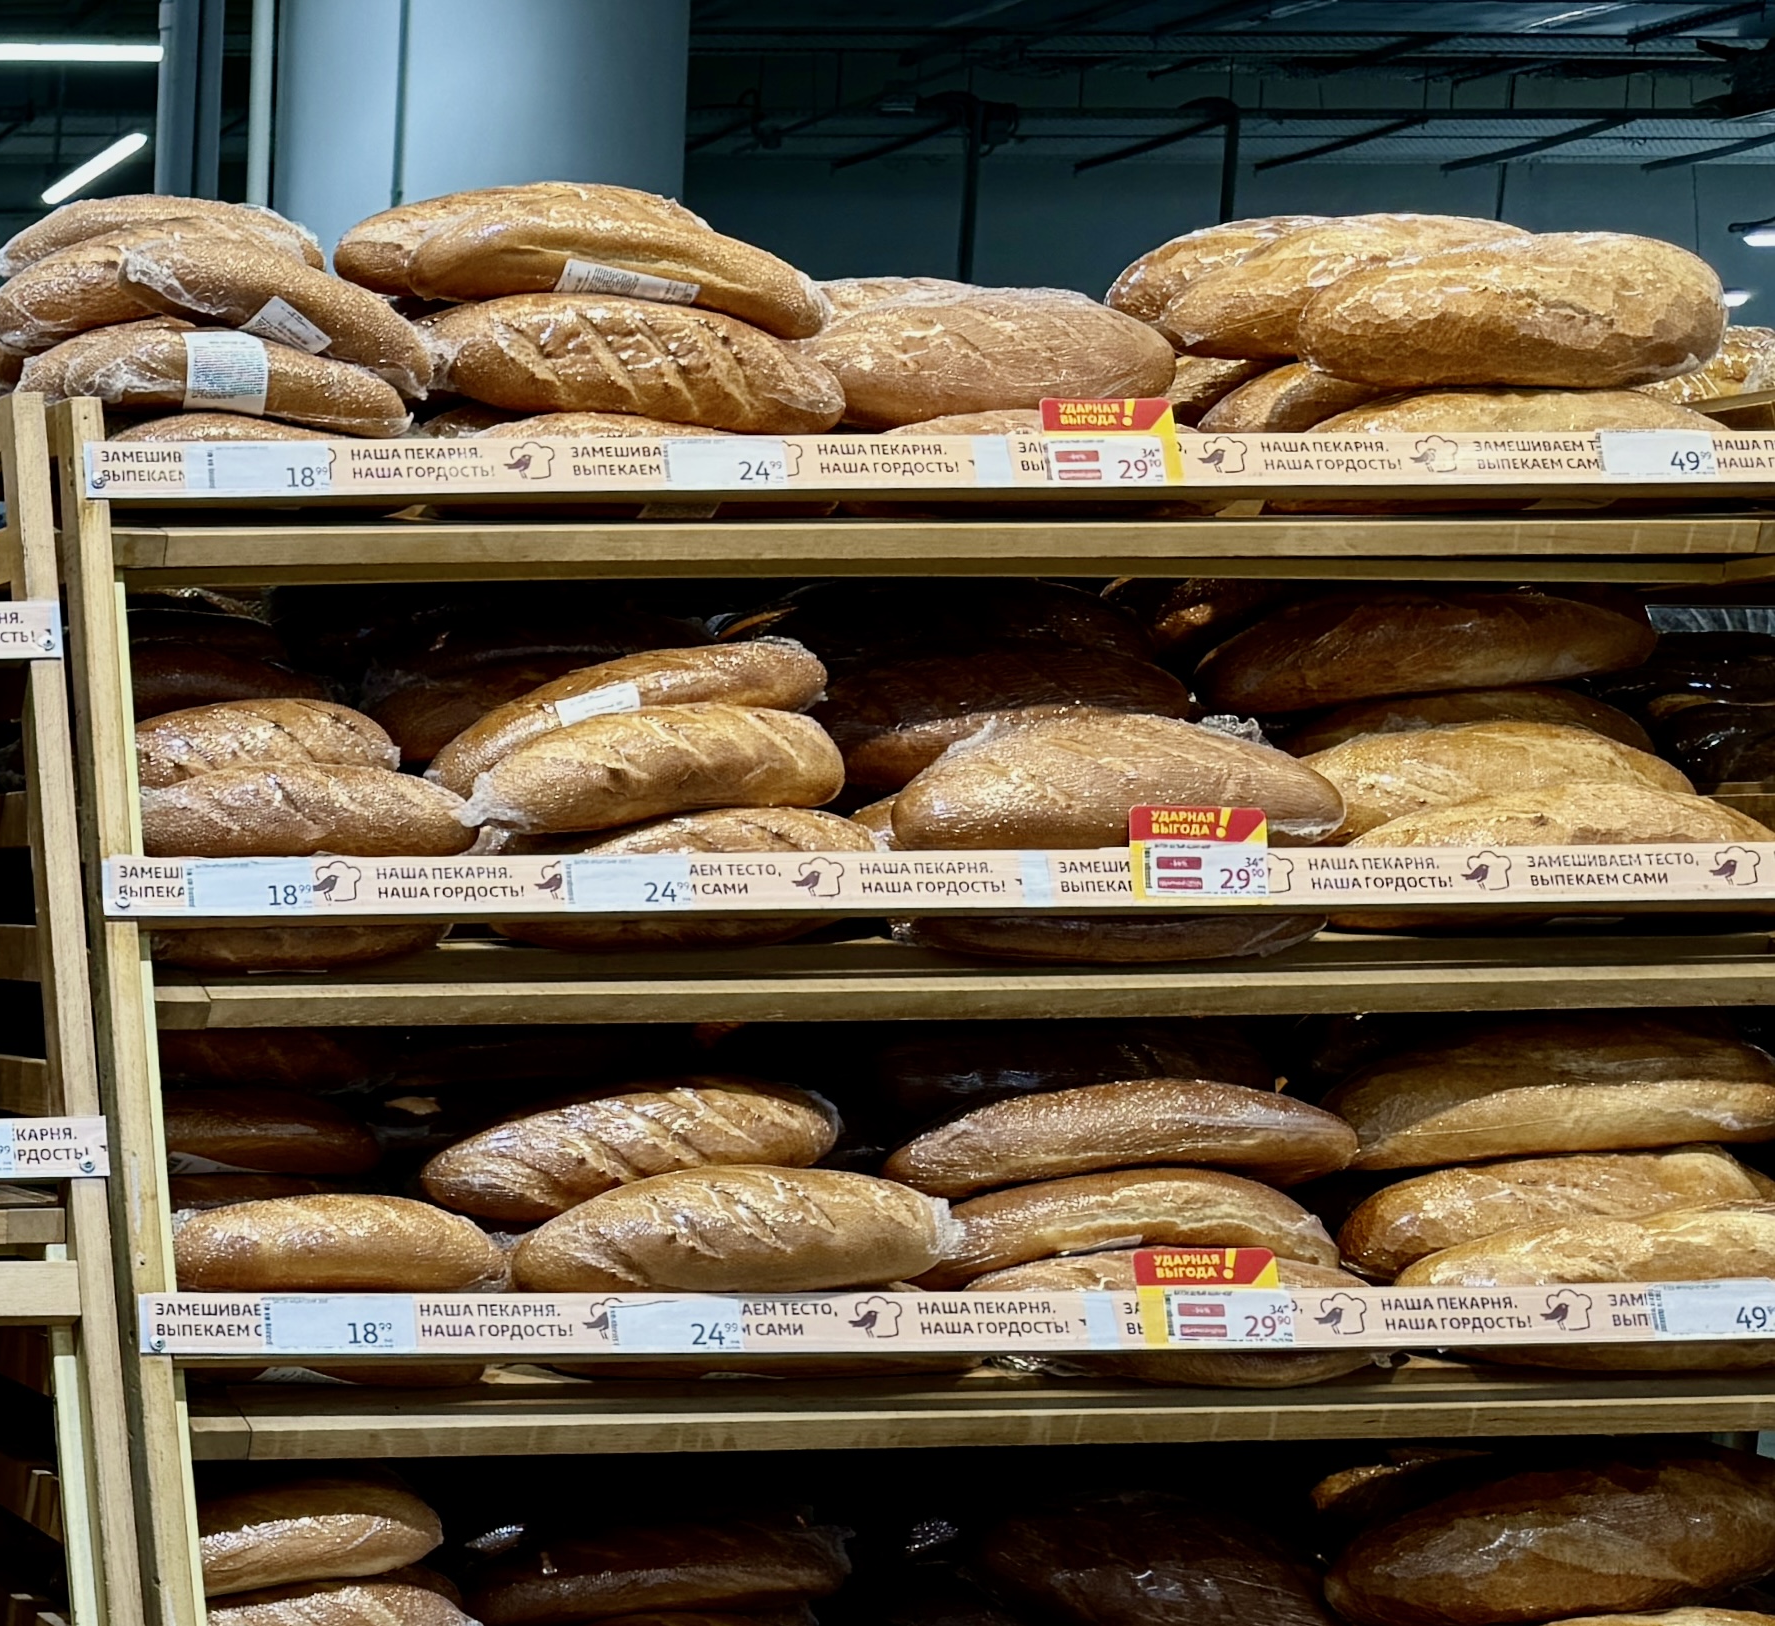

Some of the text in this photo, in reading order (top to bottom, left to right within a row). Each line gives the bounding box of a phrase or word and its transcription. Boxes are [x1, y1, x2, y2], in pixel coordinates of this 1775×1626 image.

[1058, 403, 1120, 414] УДАРНАЯ
[1060, 414, 1117, 427] ВЫГОДА
[817, 444, 947, 455] НАША ПЕКАРНЯ.
[1261, 441, 1389, 452] НАША ПЕКАРНЯ.
[351, 447, 483, 460] НАША ПЕКАРНЯ.
[820, 462, 959, 476] НАША ГОРДОСТЬ!
[1264, 459, 1401, 472] НАША ГОРДОСТЬ!
[353, 466, 494, 481] НАША ГОРДОСТЬ!
[1151, 810, 1215, 823] УДАРНАЯ
[1152, 823, 1210, 836] ВЫГОДА
[1308, 857, 1439, 870] НАША ПЕКАРНЯ.
[1527, 853, 1699, 867] ЗАМЕШИВАЕМ ТЕСТО,
[376, 867, 512, 879] НАША ПЕКАРНЯ.
[860, 862, 993, 874] НАША ПЕКАРНЯ.
[1311, 876, 1452, 892] НАША ГОРДОСТЬ!
[1531, 873, 1668, 886] ВЫПЕКАЕМ САМИ
[378, 886, 524, 901] НАША ГОРДОСТЬ!
[862, 880, 1005, 896] НАША ГОРДОСТЬ!
[1153, 1254, 1220, 1267] УДАРНАЯ
[1156, 1267, 1217, 1280] ВЫГОДА
[420, 1304, 560, 1316] НАША ПЕКАРНЯ.
[918, 1302, 1055, 1314] НАША ПЕКАРНЯ.
[1381, 1297, 1517, 1310] НАША ПЕКАРНЯ.
[921, 1321, 1069, 1337] НАША ГОРДОСТЬ!
[1385, 1316, 1532, 1333] НАША ГОРДОСТЬ!
[422, 1324, 573, 1340] НАША ГОРДОСТЬ!
